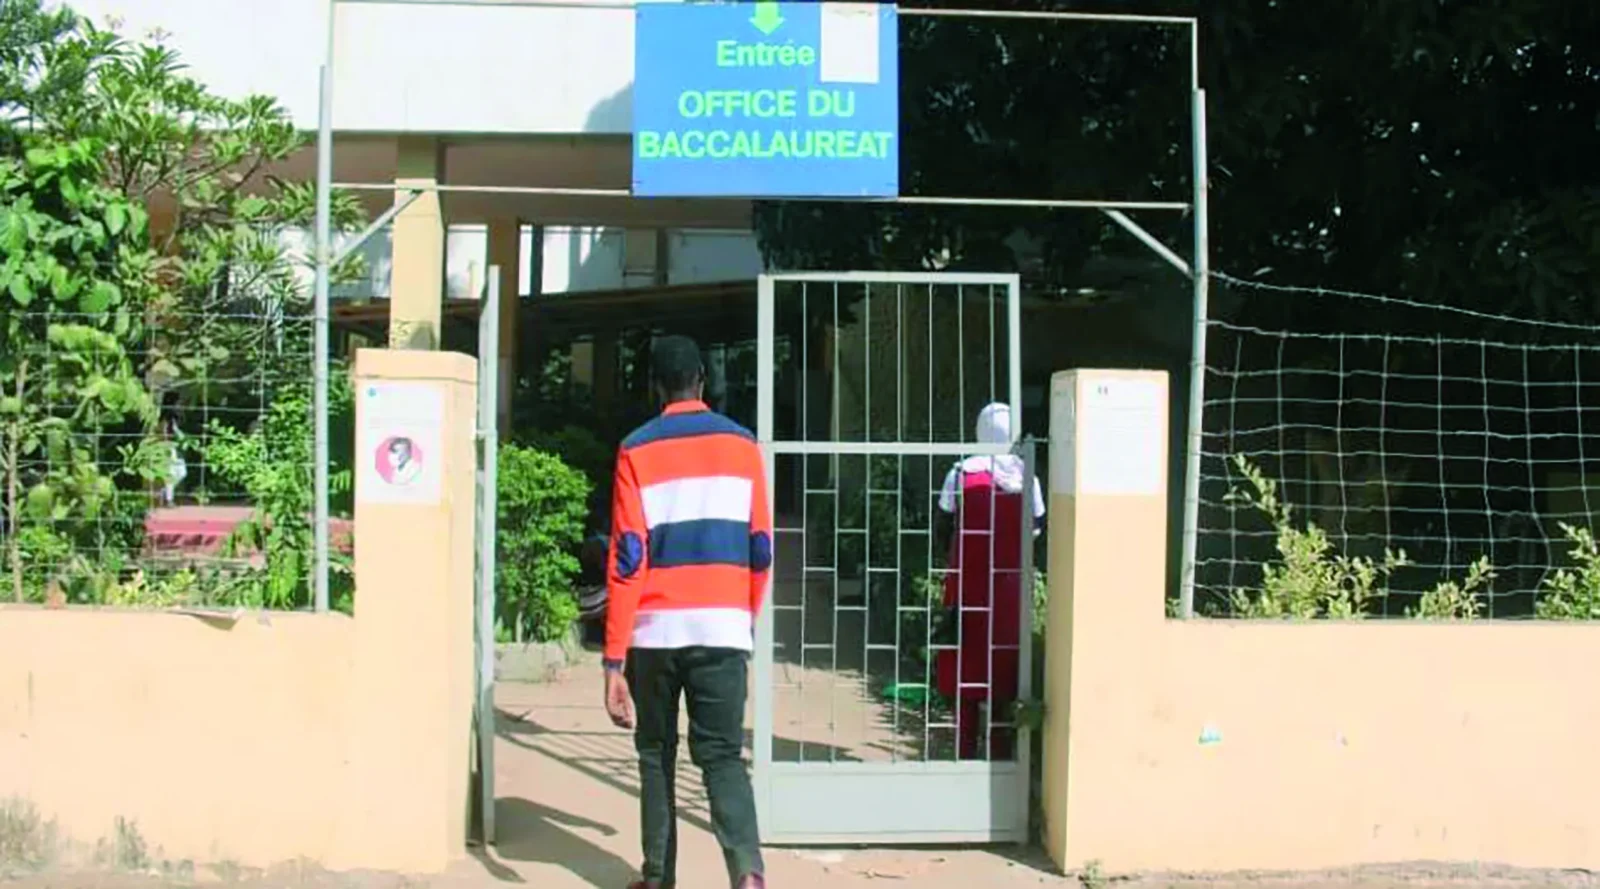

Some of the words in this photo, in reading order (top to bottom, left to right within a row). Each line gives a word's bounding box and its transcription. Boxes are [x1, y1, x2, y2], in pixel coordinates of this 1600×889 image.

[715, 39, 816, 68] Entrée
[678, 89, 797, 119] OFFICE
[807, 90, 856, 118] DU
[638, 130, 894, 160] BACCALAUREAT
